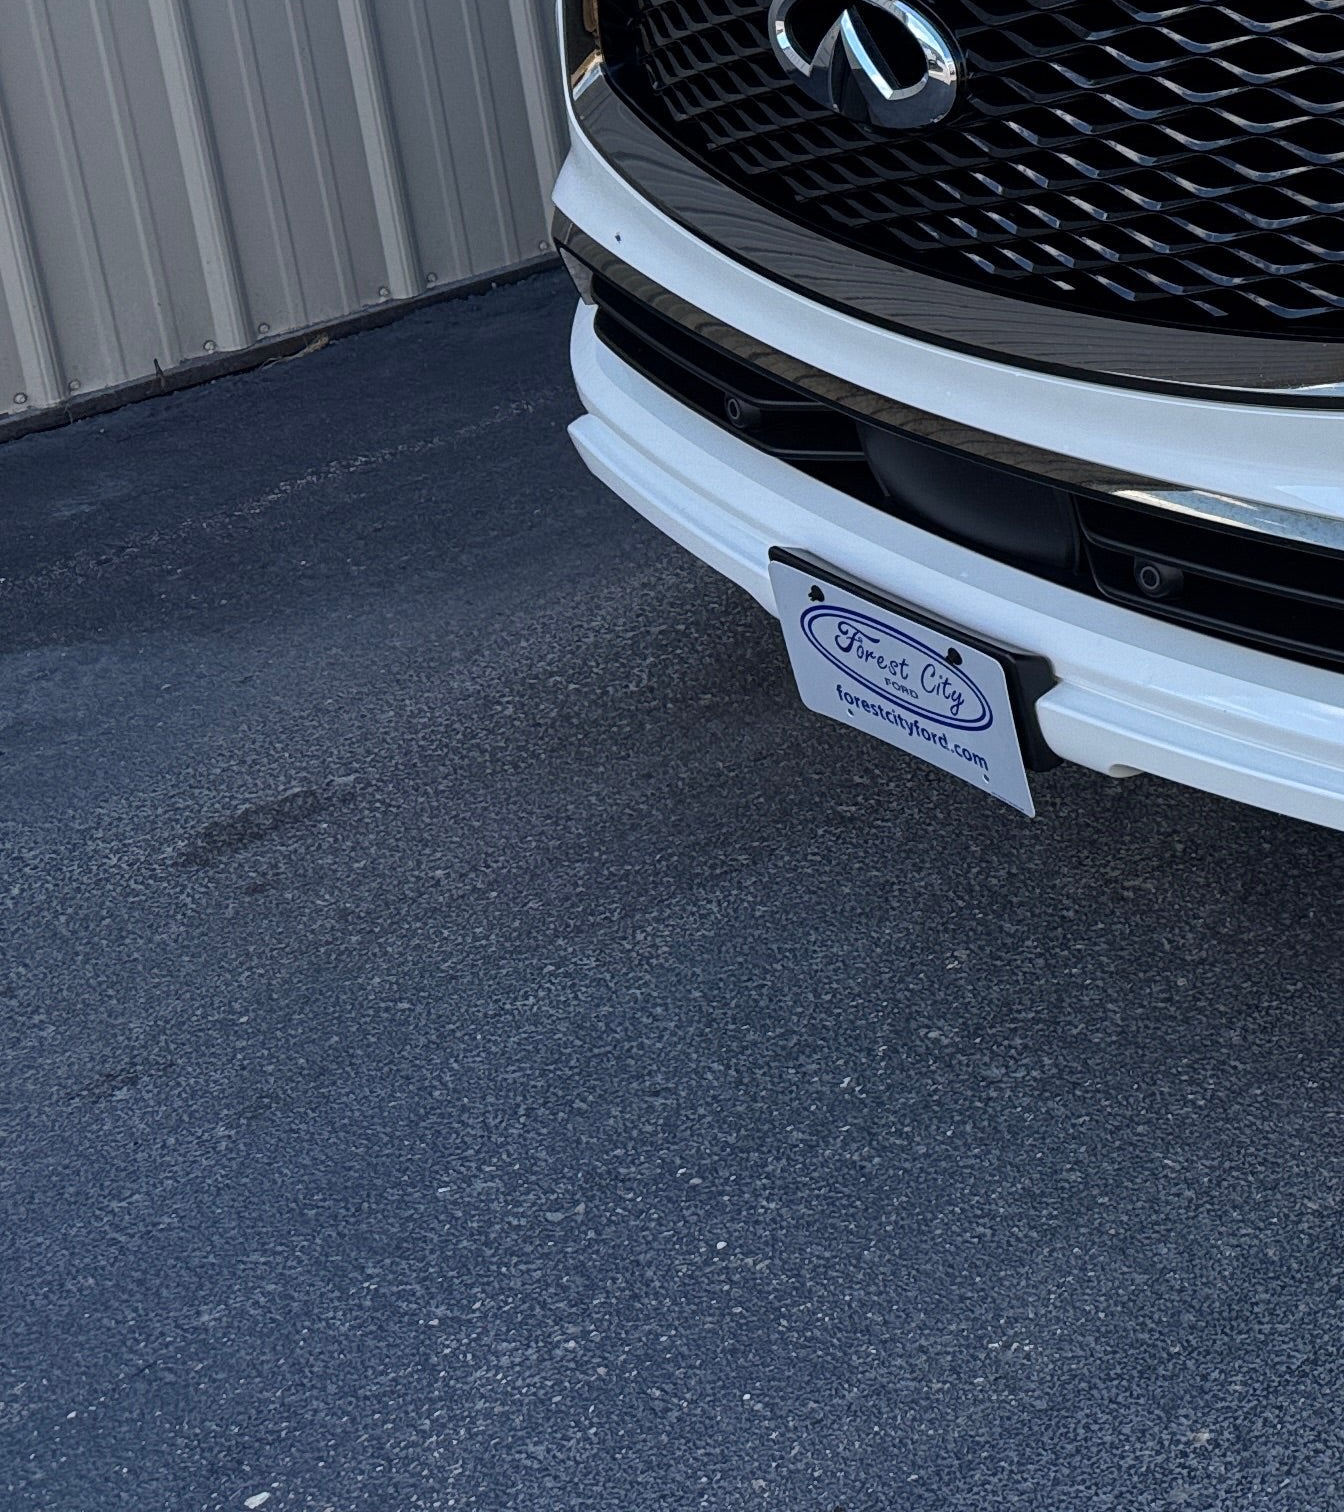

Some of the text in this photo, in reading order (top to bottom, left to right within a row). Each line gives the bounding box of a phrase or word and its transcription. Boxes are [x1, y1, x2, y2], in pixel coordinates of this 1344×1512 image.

[834, 620, 965, 717] Forest City
[836, 683, 989, 771] forestcityford.com
